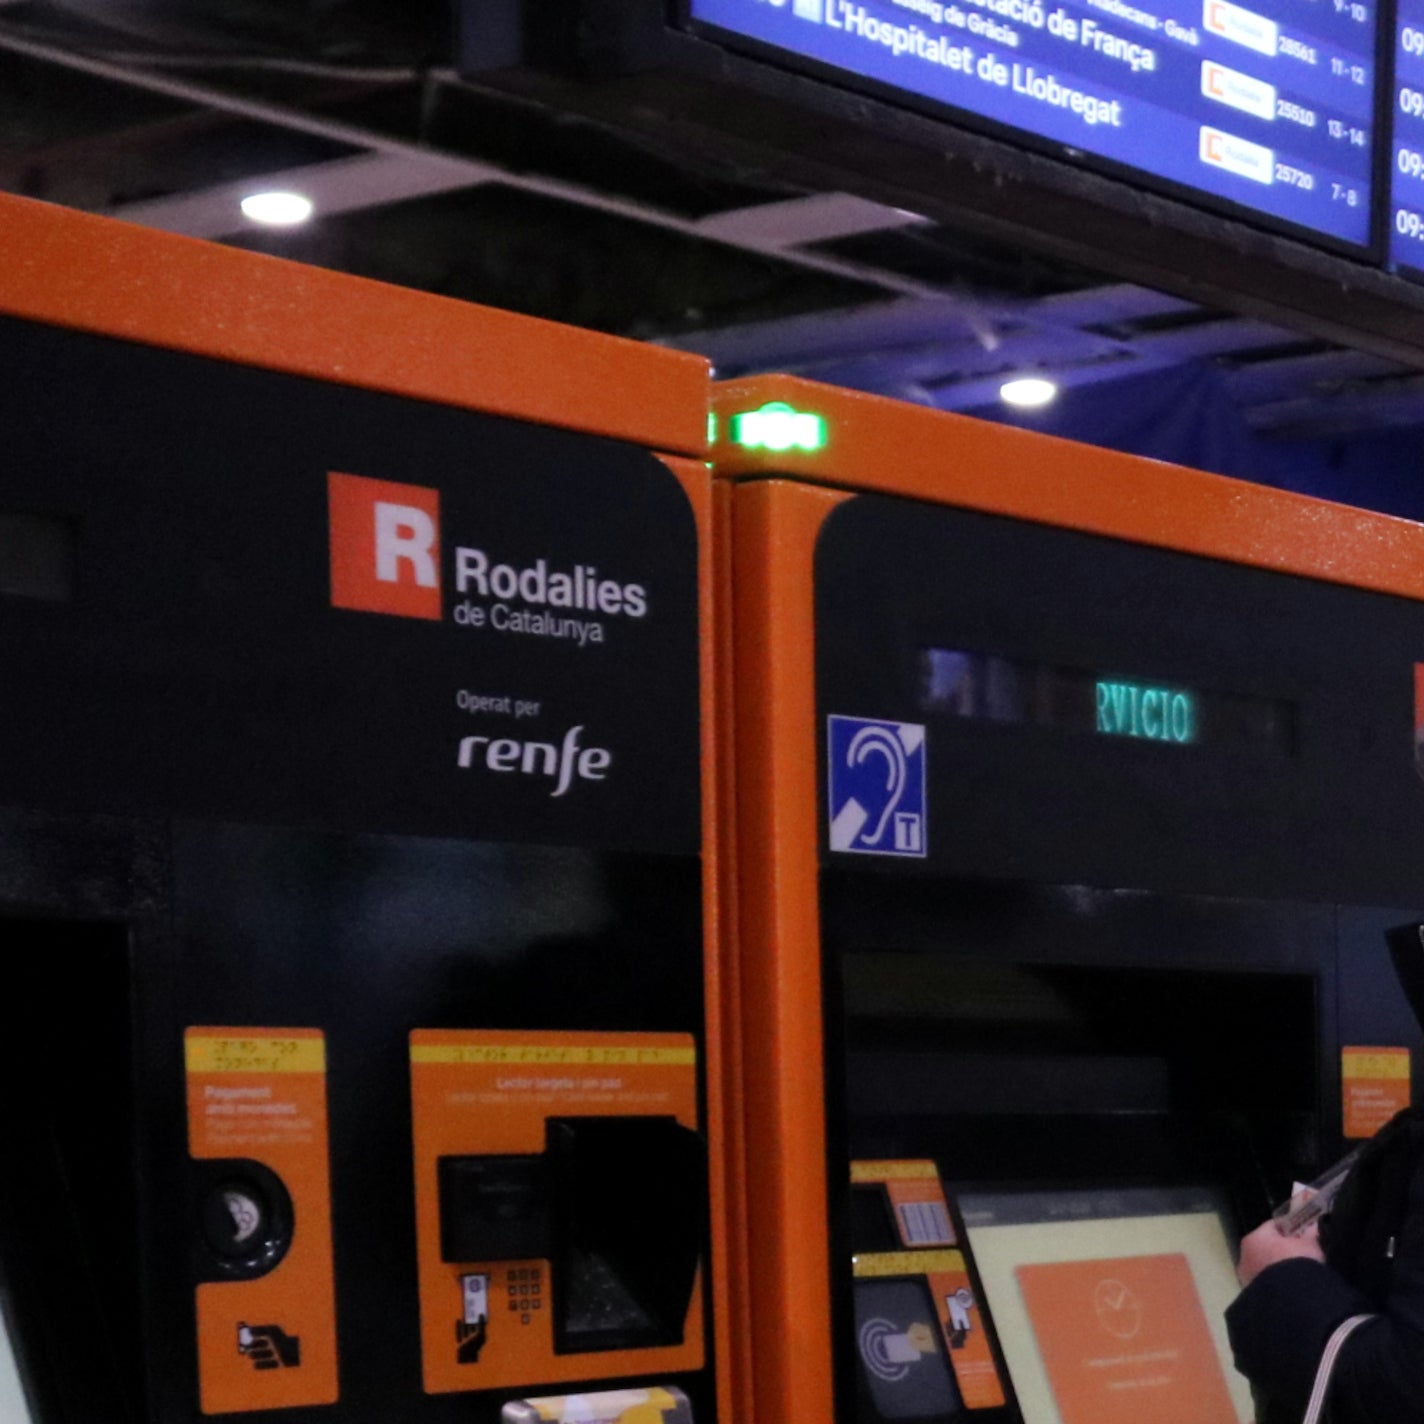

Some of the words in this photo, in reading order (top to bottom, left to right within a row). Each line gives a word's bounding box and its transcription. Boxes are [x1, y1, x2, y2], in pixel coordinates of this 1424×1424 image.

[944, 3, 965, 28] de
[967, 11, 1019, 48] Gràcia
[1278, 35, 1315, 65] 28561
[1047, 4, 1076, 42] de
[1080, 16, 1155, 78] França
[1276, 98, 1315, 129] 25510
[824, 3, 974, 73] L'Hospitalet
[976, 54, 1010, 86] de
[1011, 61, 1122, 127] Llobregat
[1274, 161, 1313, 192] 25720
[373, 501, 437, 588] R
[454, 546, 647, 618] Rodalies
[453, 600, 485, 628] de
[490, 602, 604, 646] Catalunya
[456, 689, 512, 716] Operat
[514, 697, 540, 718] per
[457, 725, 611, 797] renfe
[496, 1077, 534, 1090] Lector
[535, 1077, 576, 1091] targeta
